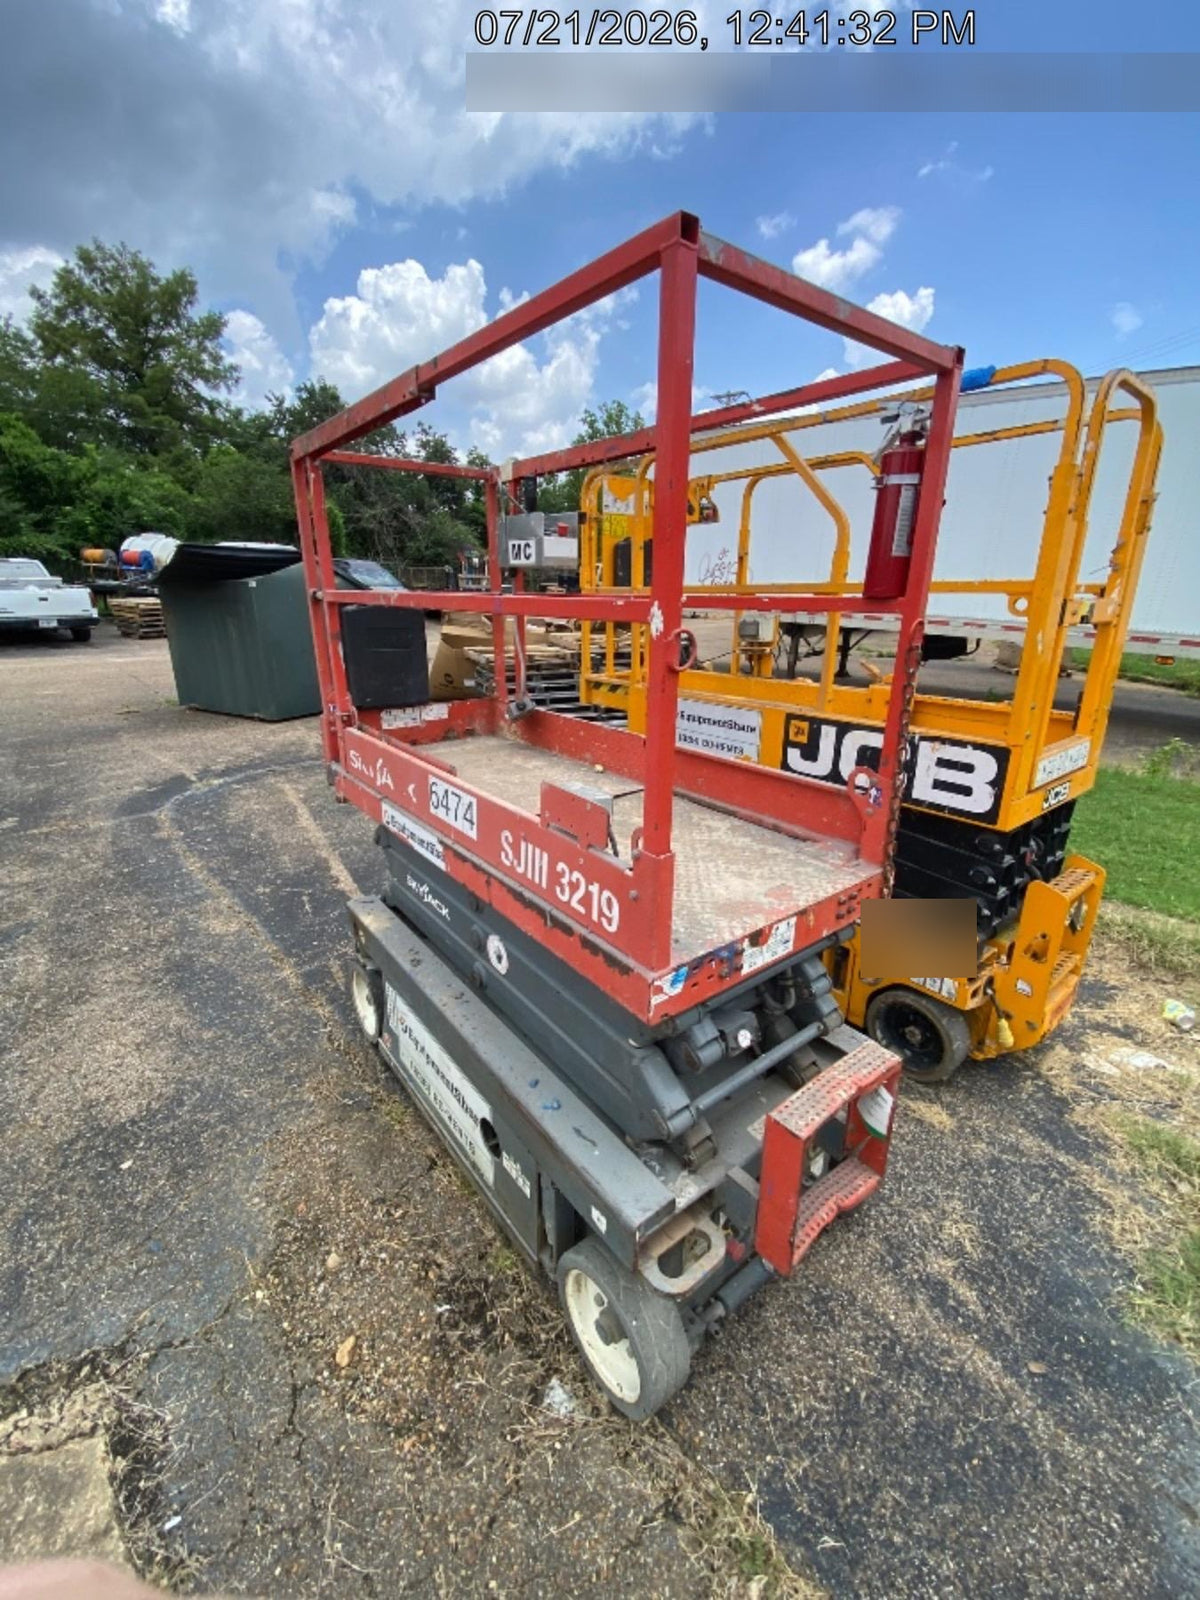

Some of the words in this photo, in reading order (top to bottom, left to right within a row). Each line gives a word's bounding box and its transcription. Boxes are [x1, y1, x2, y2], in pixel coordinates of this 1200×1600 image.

[510, 542, 532, 561] MC
[429, 781, 475, 831] 6474
[555, 861, 620, 932] 3219
